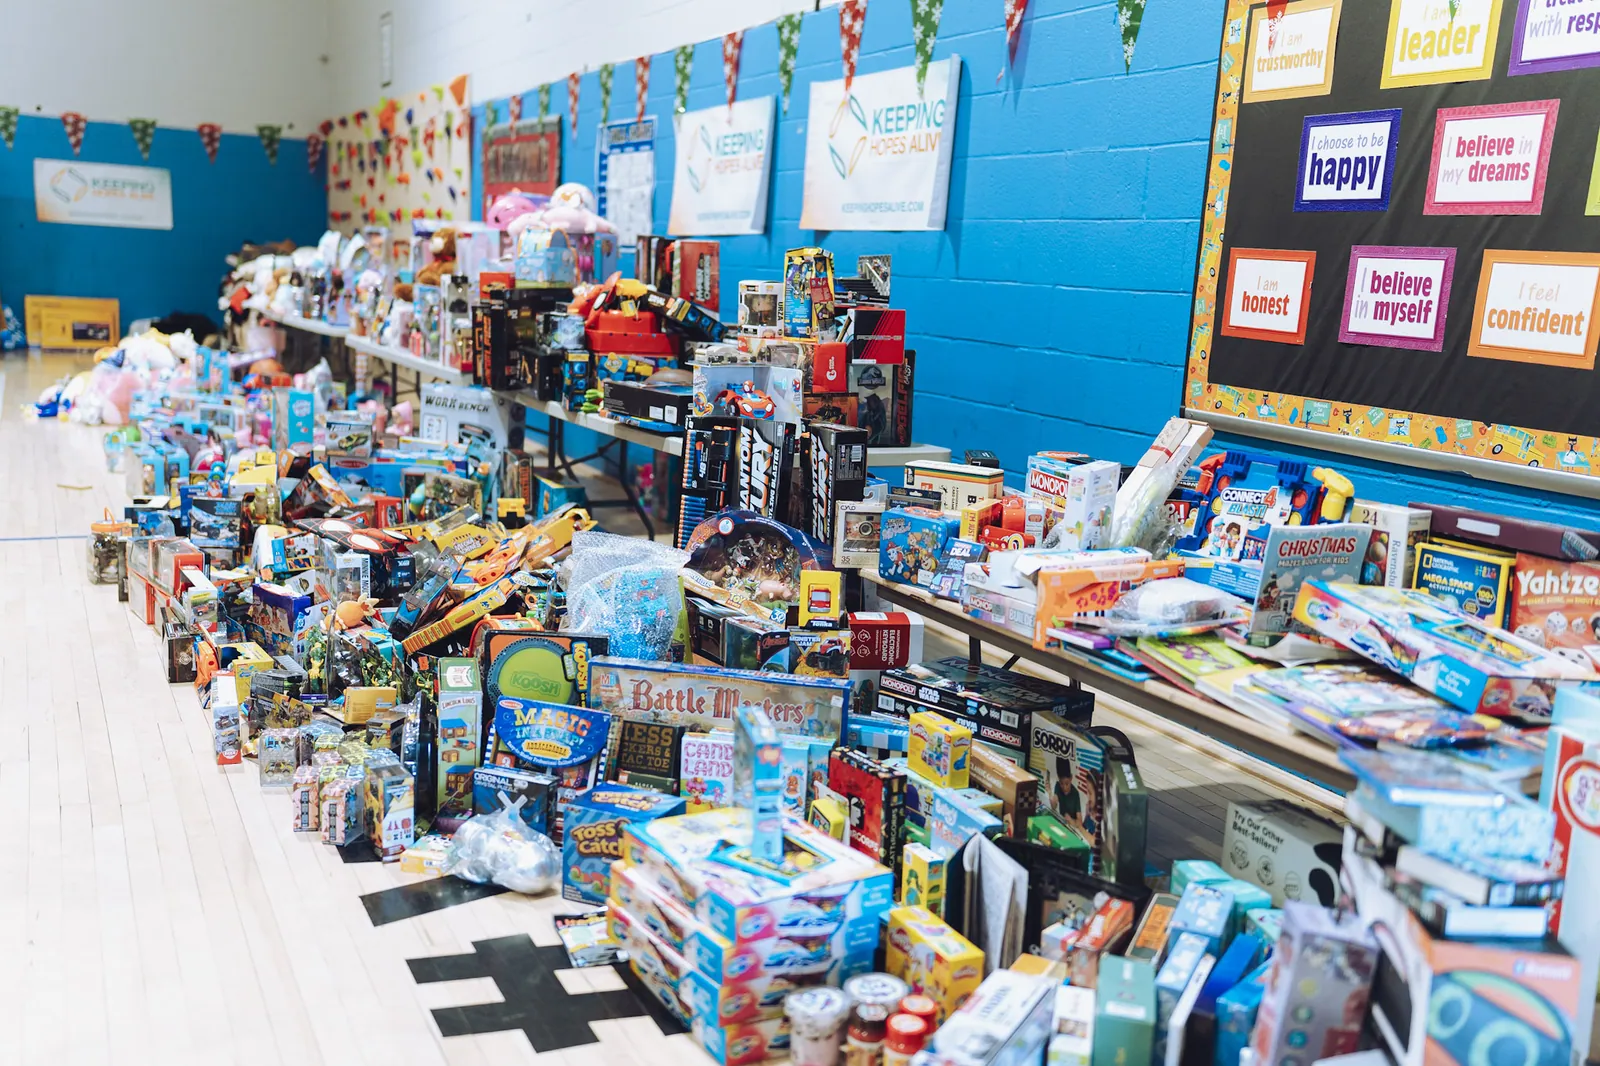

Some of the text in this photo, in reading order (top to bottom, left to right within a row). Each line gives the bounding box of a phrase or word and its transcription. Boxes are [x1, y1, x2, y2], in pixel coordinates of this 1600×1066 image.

[1529, 12, 1562, 38] with
[1280, 31, 1303, 48] I am
[1399, 20, 1481, 62] leader
[1257, 48, 1324, 73] trustworthy
[873, 99, 946, 136] KEEPING
[715, 128, 765, 156] KEEPING
[871, 132, 944, 156] HOPES ALIV
[1311, 133, 1384, 151] I choose to be
[1446, 135, 1533, 158] I believe in
[1309, 153, 1382, 191] happy
[1442, 161, 1531, 186] my dreams
[1257, 276, 1278, 291] I am
[1361, 267, 1433, 297] I believe
[1518, 282, 1561, 302] I feel
[1241, 291, 1290, 316] honest
[1354, 295, 1434, 326] in myself
[1487, 307, 1585, 336] confident
[426, 395, 489, 413] WORK BENCH
[739, 425, 753, 513] HANTOM
[750, 427, 774, 515] URY
[770, 447, 782, 489] BLASTER
[811, 433, 819, 540] PHANTOM
[817, 436, 831, 544] FURY
[1221, 487, 1277, 508] CONNECT 4
[1226, 503, 1267, 519] BLAST!
[1362, 509, 1379, 526] 24
[949, 548, 972, 558] DEAL
[1277, 536, 1358, 558] CHRISTMAS
[1319, 557, 1331, 565] FOR
[1332, 556, 1350, 564] KIDS
[361, 557, 370, 599] MINNIE MOU
[1422, 572, 1475, 592] MEGA SPACE
[1428, 582, 1466, 596] ACTIVITY KIT
[1516, 569, 1600, 598] Yahtze
[729, 591, 746, 604] TOY
[810, 620, 833, 628] Tonka
[1008, 607, 1035, 627] BUILDE
[789, 635, 822, 643] MONSTER
[881, 629, 889, 662] KEYBOARD
[888, 629, 896, 666] ELECTRONIC
[573, 642, 589, 691] KOOSH
[511, 673, 560, 696] KOOSH
[881, 677, 917, 695] MONOPOLY
[628, 679, 805, 725] Battle Mters
[513, 707, 593, 738] MAGIC
[515, 727, 529, 739] IN
[623, 721, 674, 747] ESS
[983, 728, 1021, 745] MONOPOLY
[1034, 729, 1075, 760] SORRY!
[646, 756, 671, 769] TOE
[664, 747, 672, 758] &
[473, 772, 513, 786] ORIGINAL
[683, 758, 734, 778] LAND
[572, 820, 617, 842] Toss
[1232, 821, 1279, 854] Best-Sellers!
[1233, 810, 1285, 845] Try Our Other
